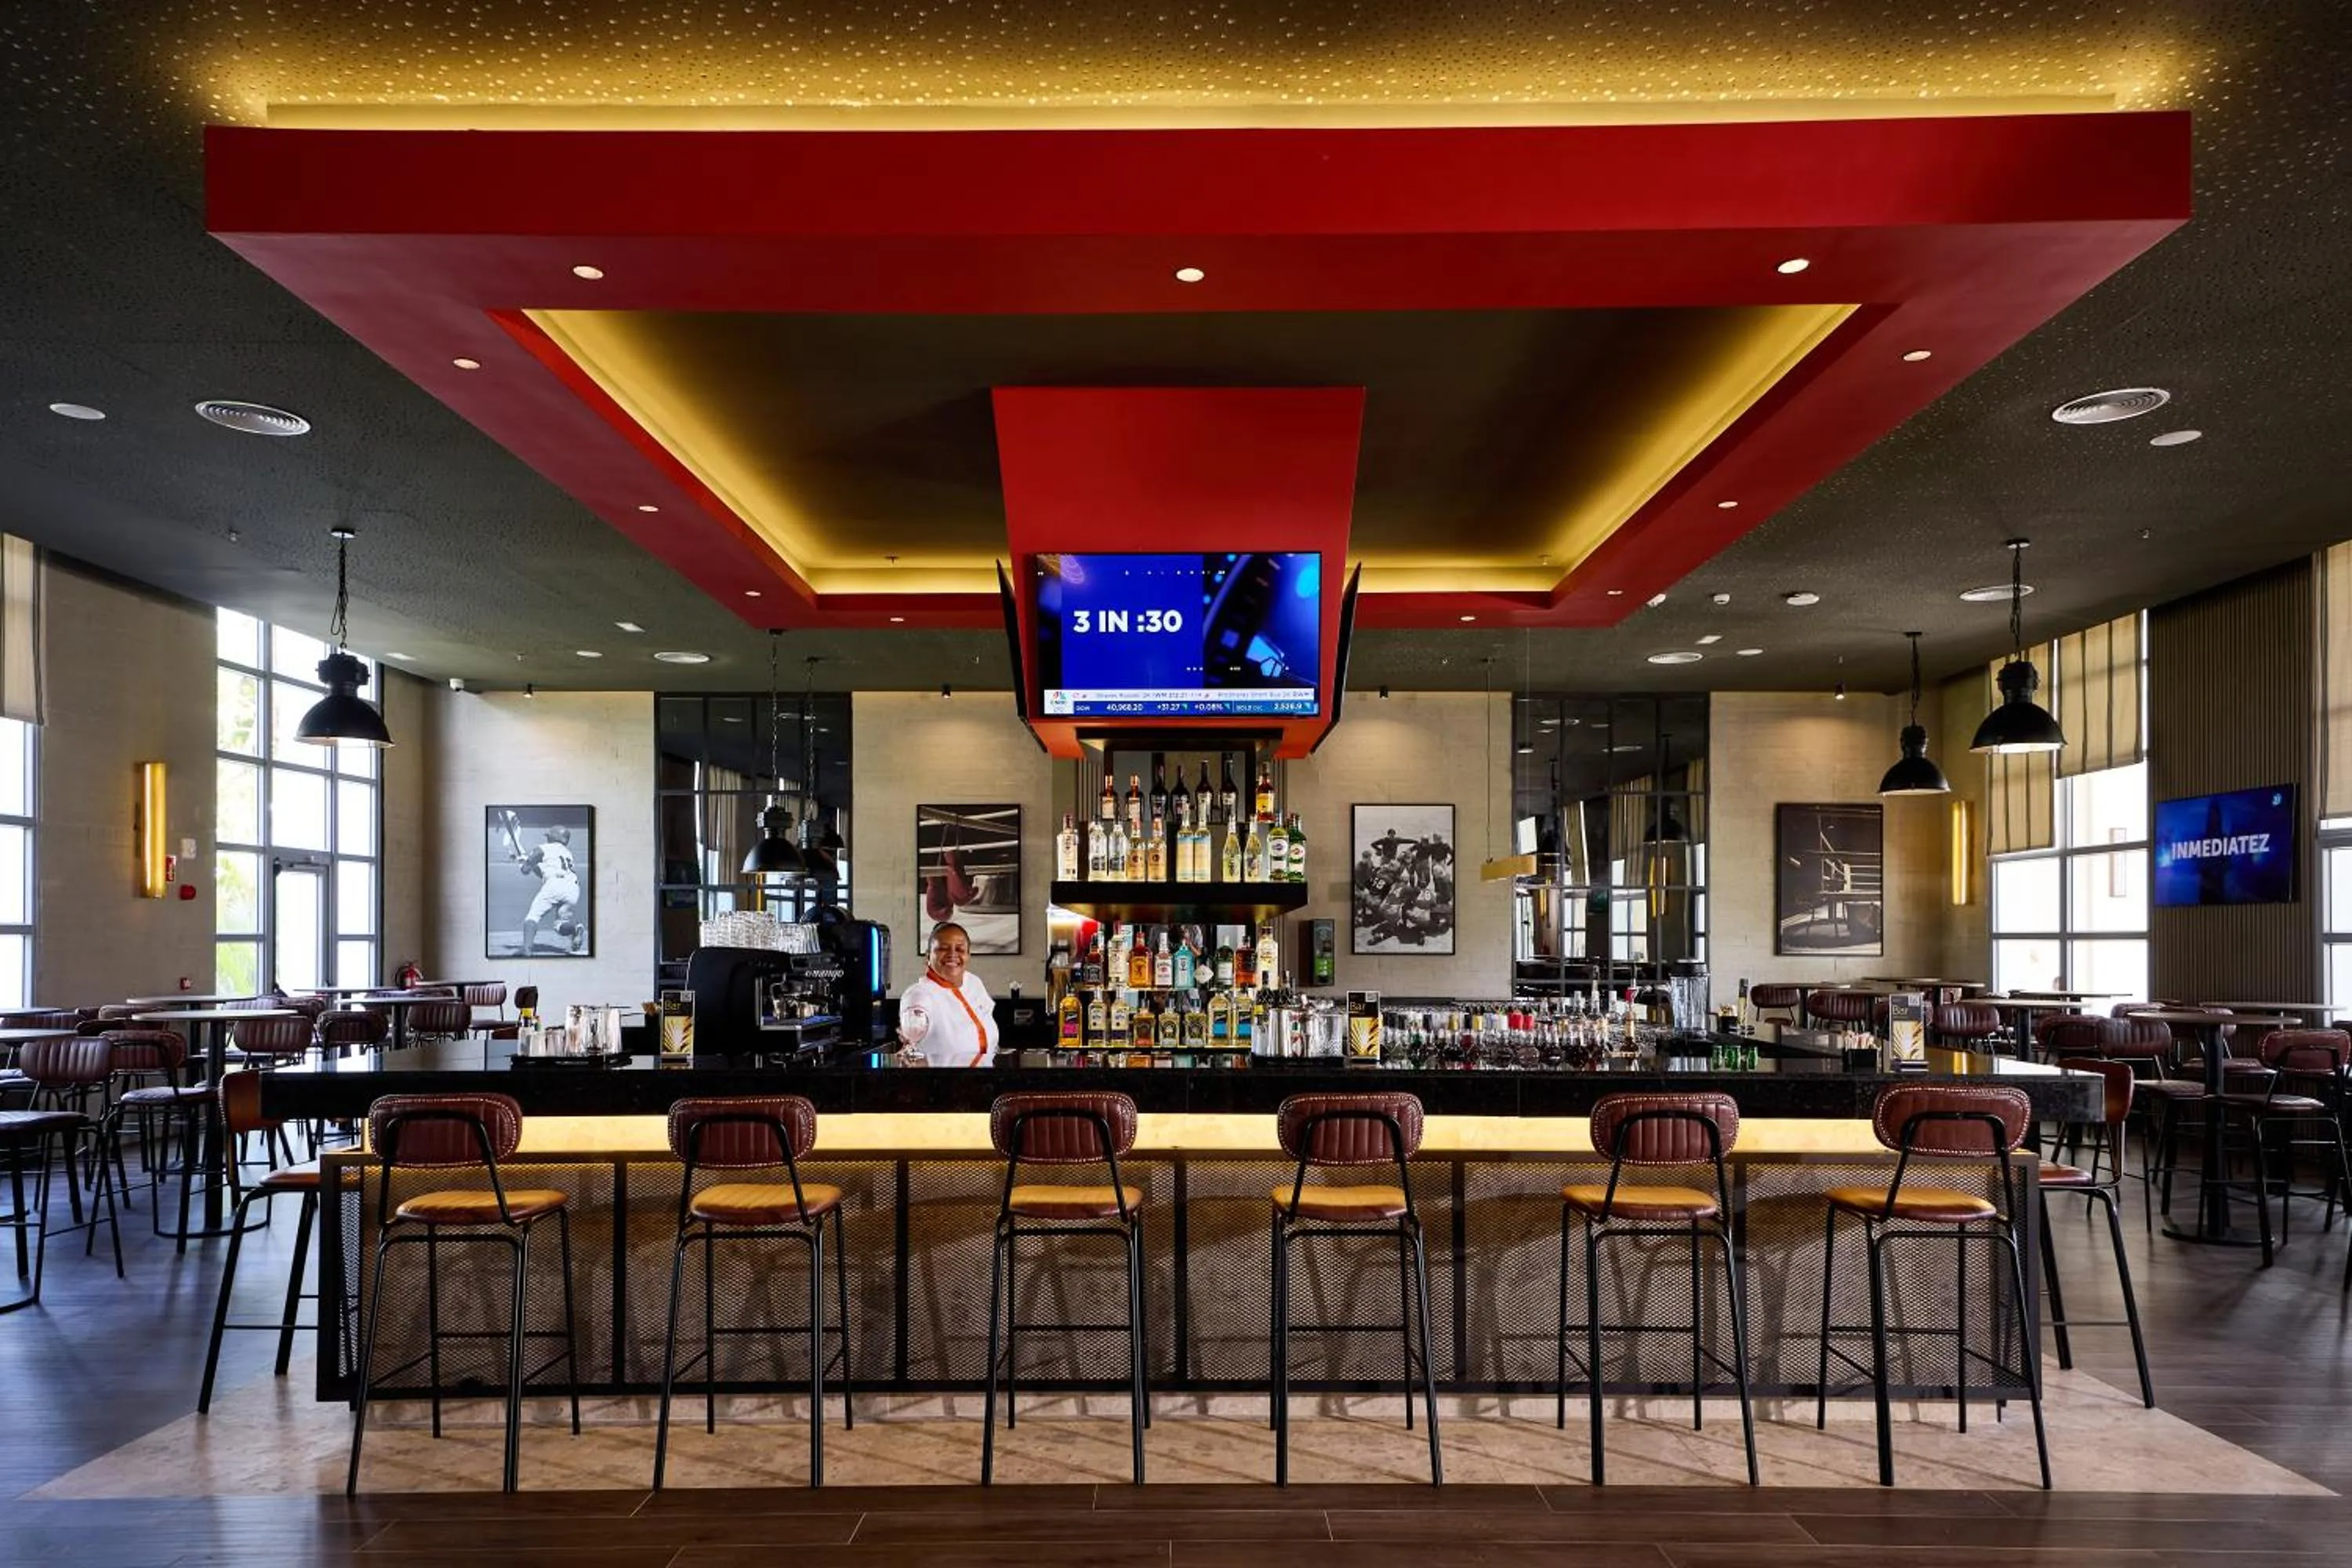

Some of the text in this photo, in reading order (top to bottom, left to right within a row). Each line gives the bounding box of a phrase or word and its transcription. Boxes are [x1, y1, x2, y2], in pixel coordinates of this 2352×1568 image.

[1073, 610, 1182, 633] 3 IN :30
[2171, 833, 2270, 860] INMEDIATEZ
[1349, 1001, 1366, 1011] Bar
